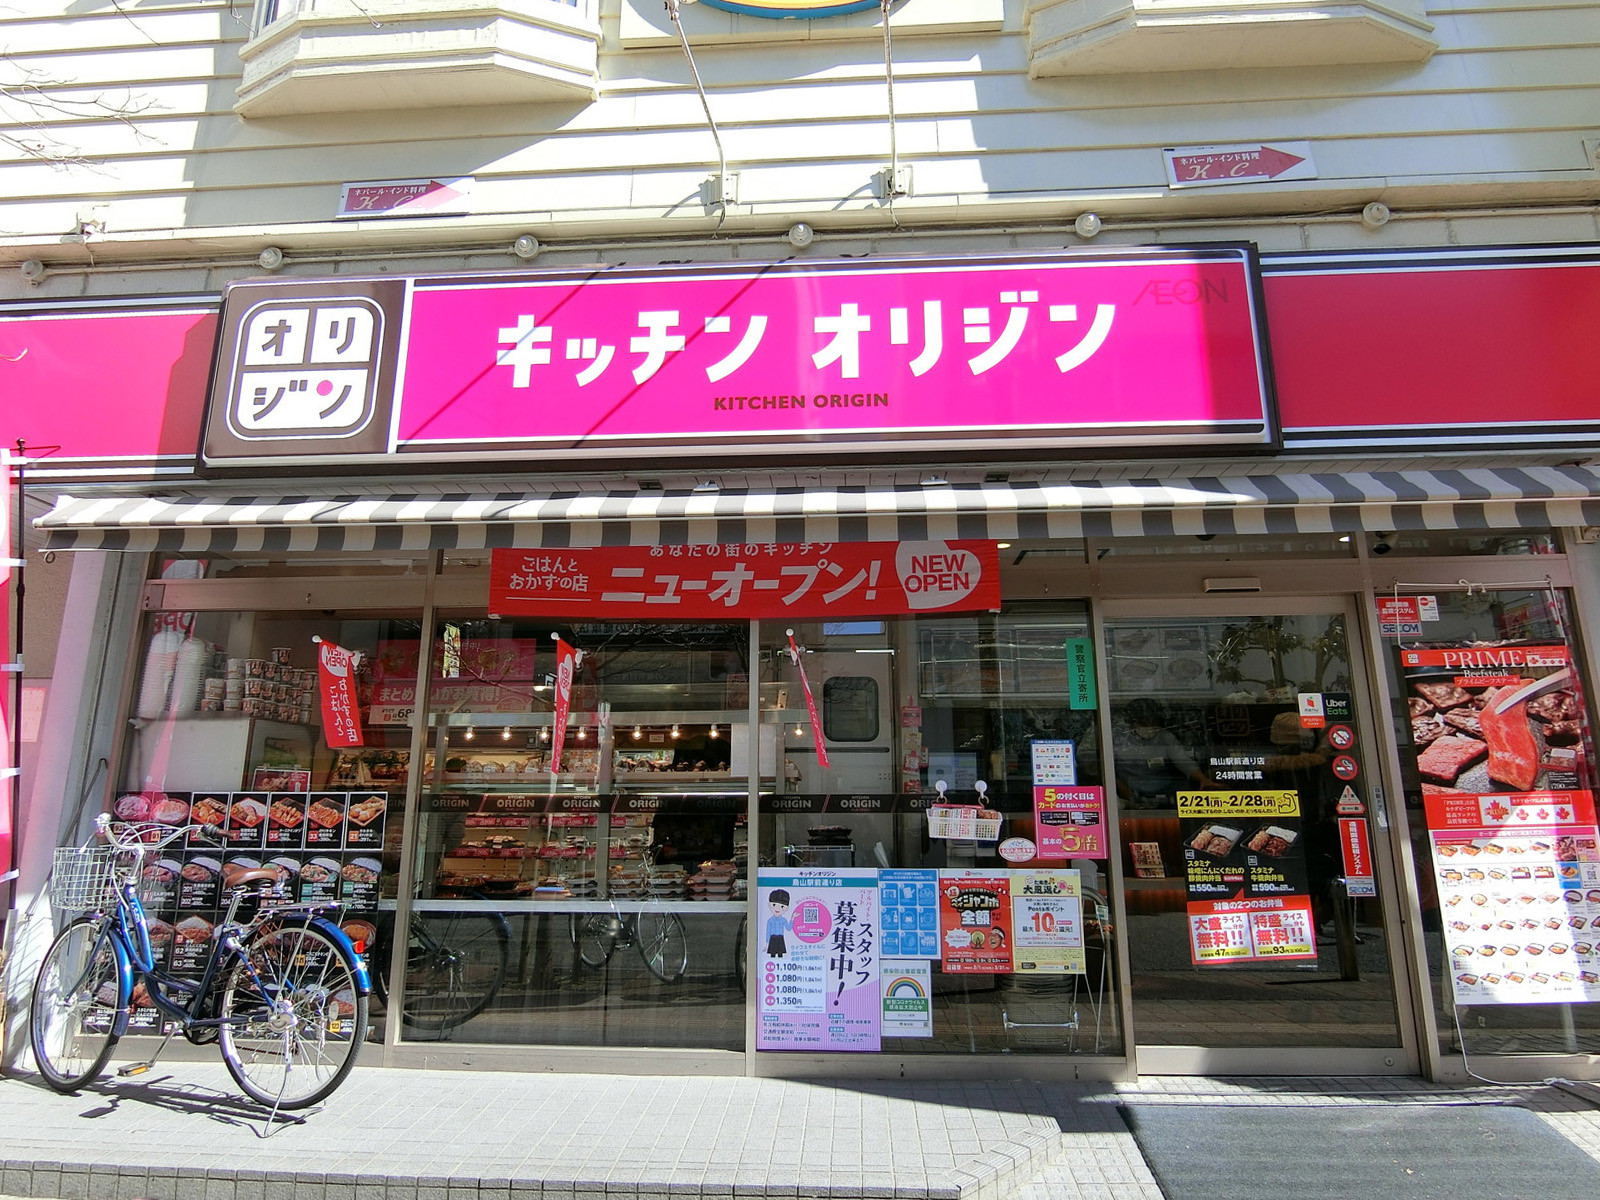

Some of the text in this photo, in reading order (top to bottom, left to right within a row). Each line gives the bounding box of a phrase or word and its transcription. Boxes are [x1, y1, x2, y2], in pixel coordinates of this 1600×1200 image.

[1180, 152, 1261, 166] ネパール・インド料理
[355, 186, 427, 196] ネパール・インド料理
[496, 290, 1115, 388] キッチン オリジン
[714, 393, 889, 410] KITCHEN ORIGIN
[650, 543, 833, 557] あなたの街のキッチン
[521, 556, 578, 573] ごはんと
[911, 553, 966, 574] NEW
[509, 573, 589, 592] おかずの店
[601, 559, 882, 607] ニューオープン!
[904, 573, 970, 593] OPEN
[1443, 650, 1525, 669] PRIME
[1075, 644, 1088, 702] 警察官立寄所
[1463, 669, 1509, 678] Beefsteak
[1326, 699, 1346, 707] Uber
[1215, 771, 1263, 780] 24時間営業
[1044, 788, 1095, 802] 5の付く日は
[497, 799, 535, 808] ORIGIN
[562, 799, 600, 808] ORIGIN
[772, 799, 812, 808] ORIGIN
[840, 799, 881, 808] ORIGIN
[1250, 866, 1274, 874] スタミナ
[1213, 899, 1283, 910] 対象の2つのお弁当
[1194, 916, 1222, 931] 大盛
[1253, 913, 1281, 928] 特盛
[830, 901, 857, 1006] 募集中!
[856, 922, 873, 986] スタッフ
